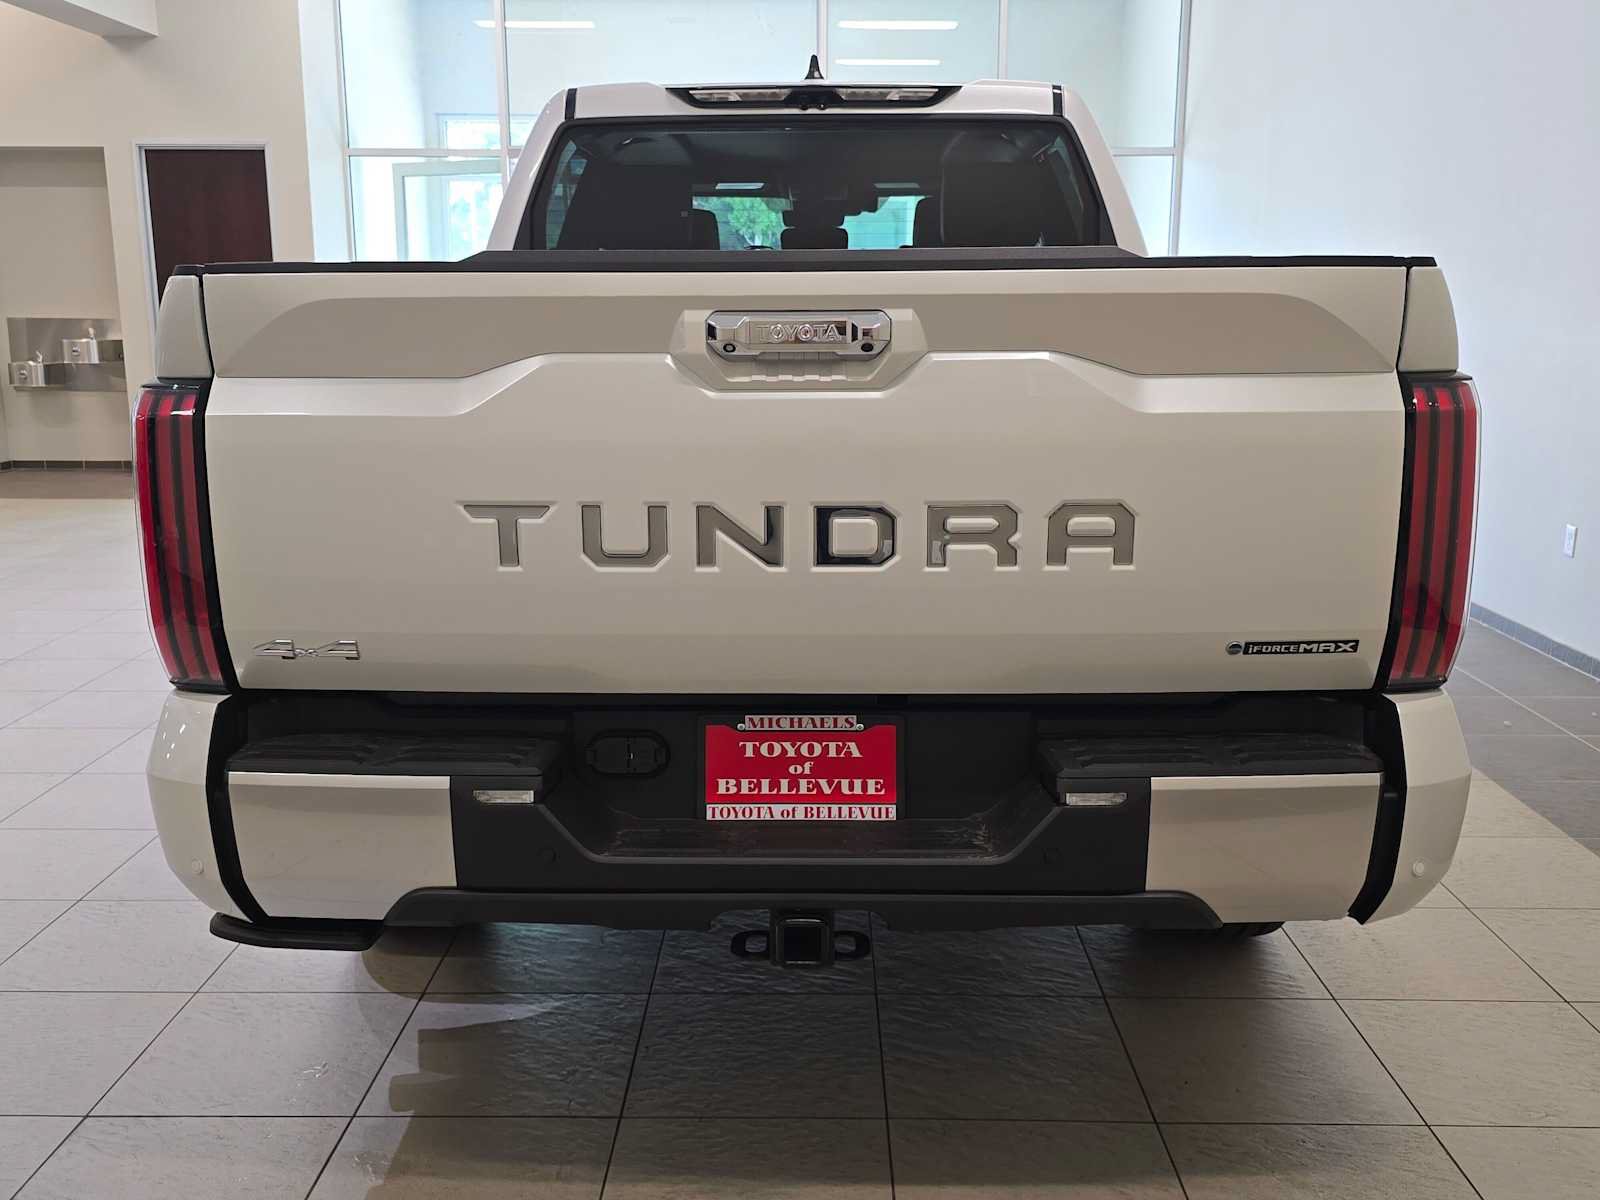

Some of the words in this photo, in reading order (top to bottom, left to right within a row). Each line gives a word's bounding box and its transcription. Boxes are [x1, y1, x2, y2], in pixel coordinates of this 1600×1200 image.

[757, 323, 842, 342] TOYOTA
[459, 501, 1136, 571] TUNDRA
[748, 716, 856, 729] MICHAELS
[739, 741, 863, 758] TOYOTA
[788, 761, 814, 775] of
[716, 778, 885, 795] BELLEVUE
[708, 806, 774, 819] TOYOTA
[780, 806, 798, 819] of
[803, 806, 896, 819] BELLEVUE
